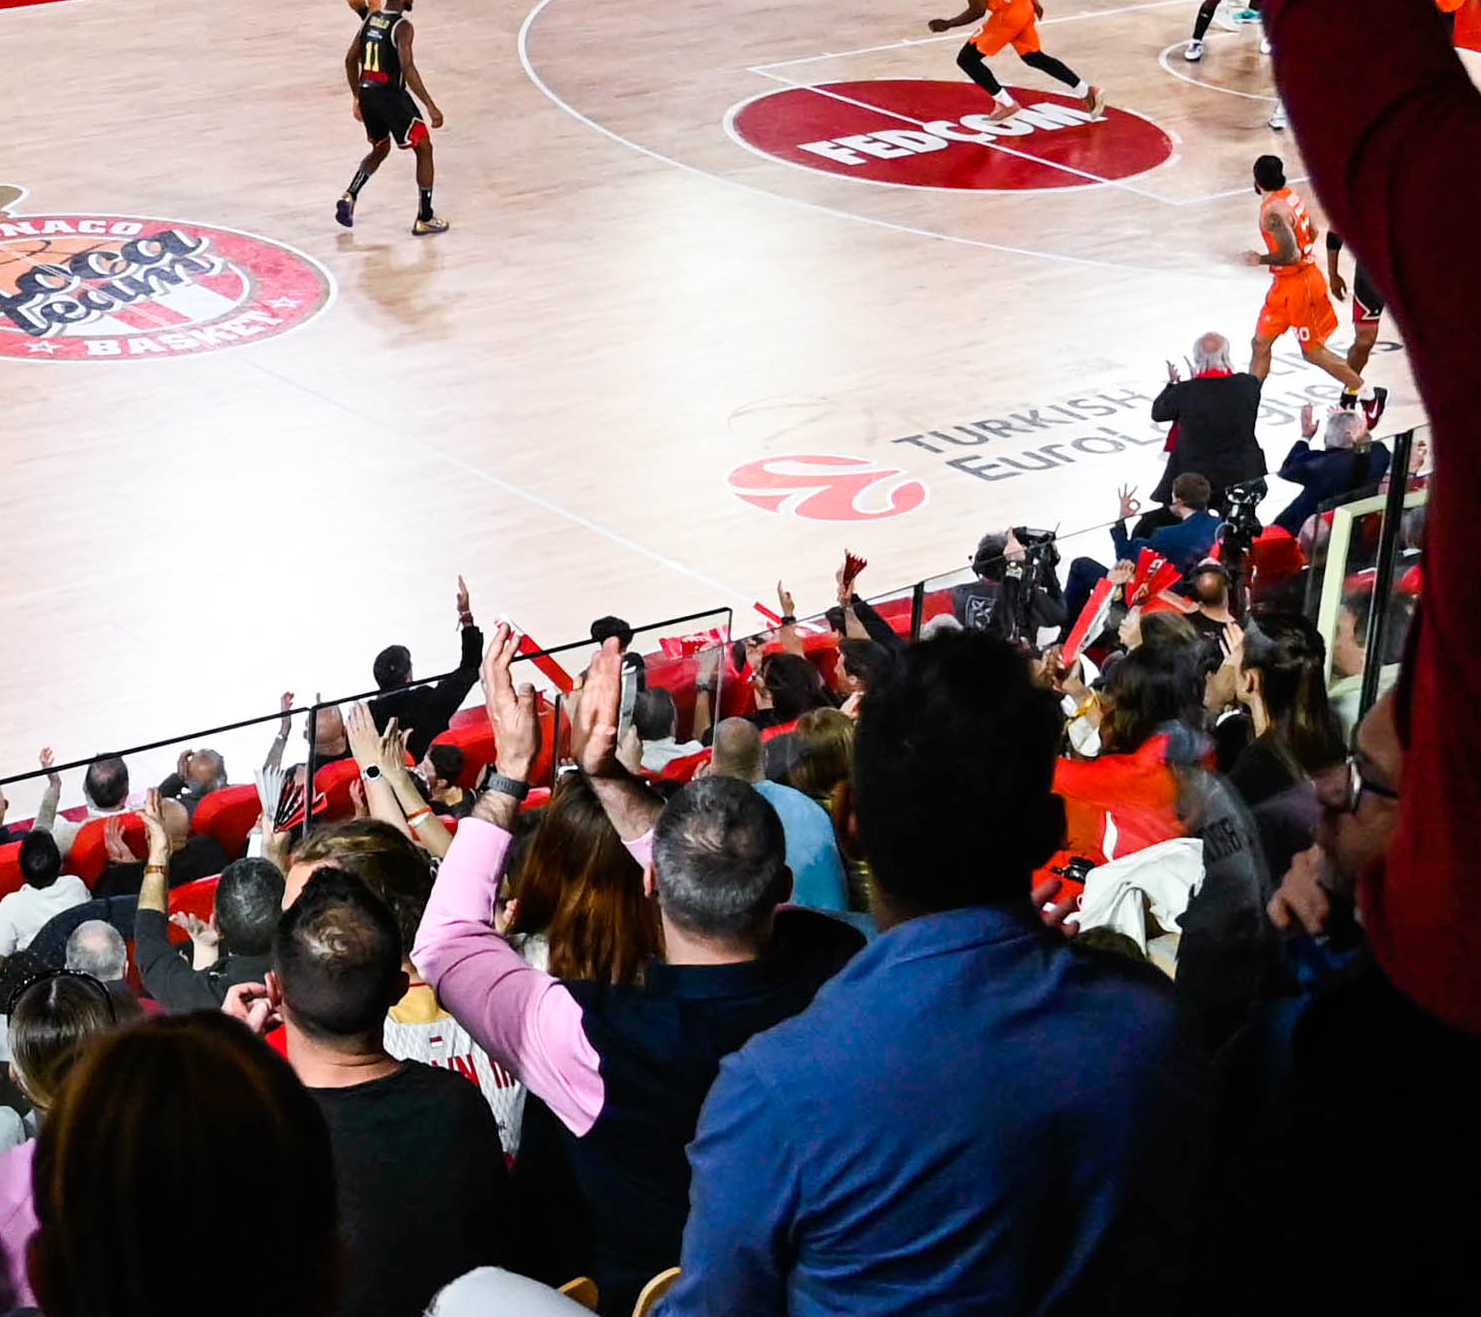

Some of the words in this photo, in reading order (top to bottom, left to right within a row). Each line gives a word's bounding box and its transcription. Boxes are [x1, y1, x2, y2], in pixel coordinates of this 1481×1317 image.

[797, 102, 1108, 165] FEDCOM
[87, 311, 289, 358] BASKET
[891, 386, 1150, 456] TURKISH
